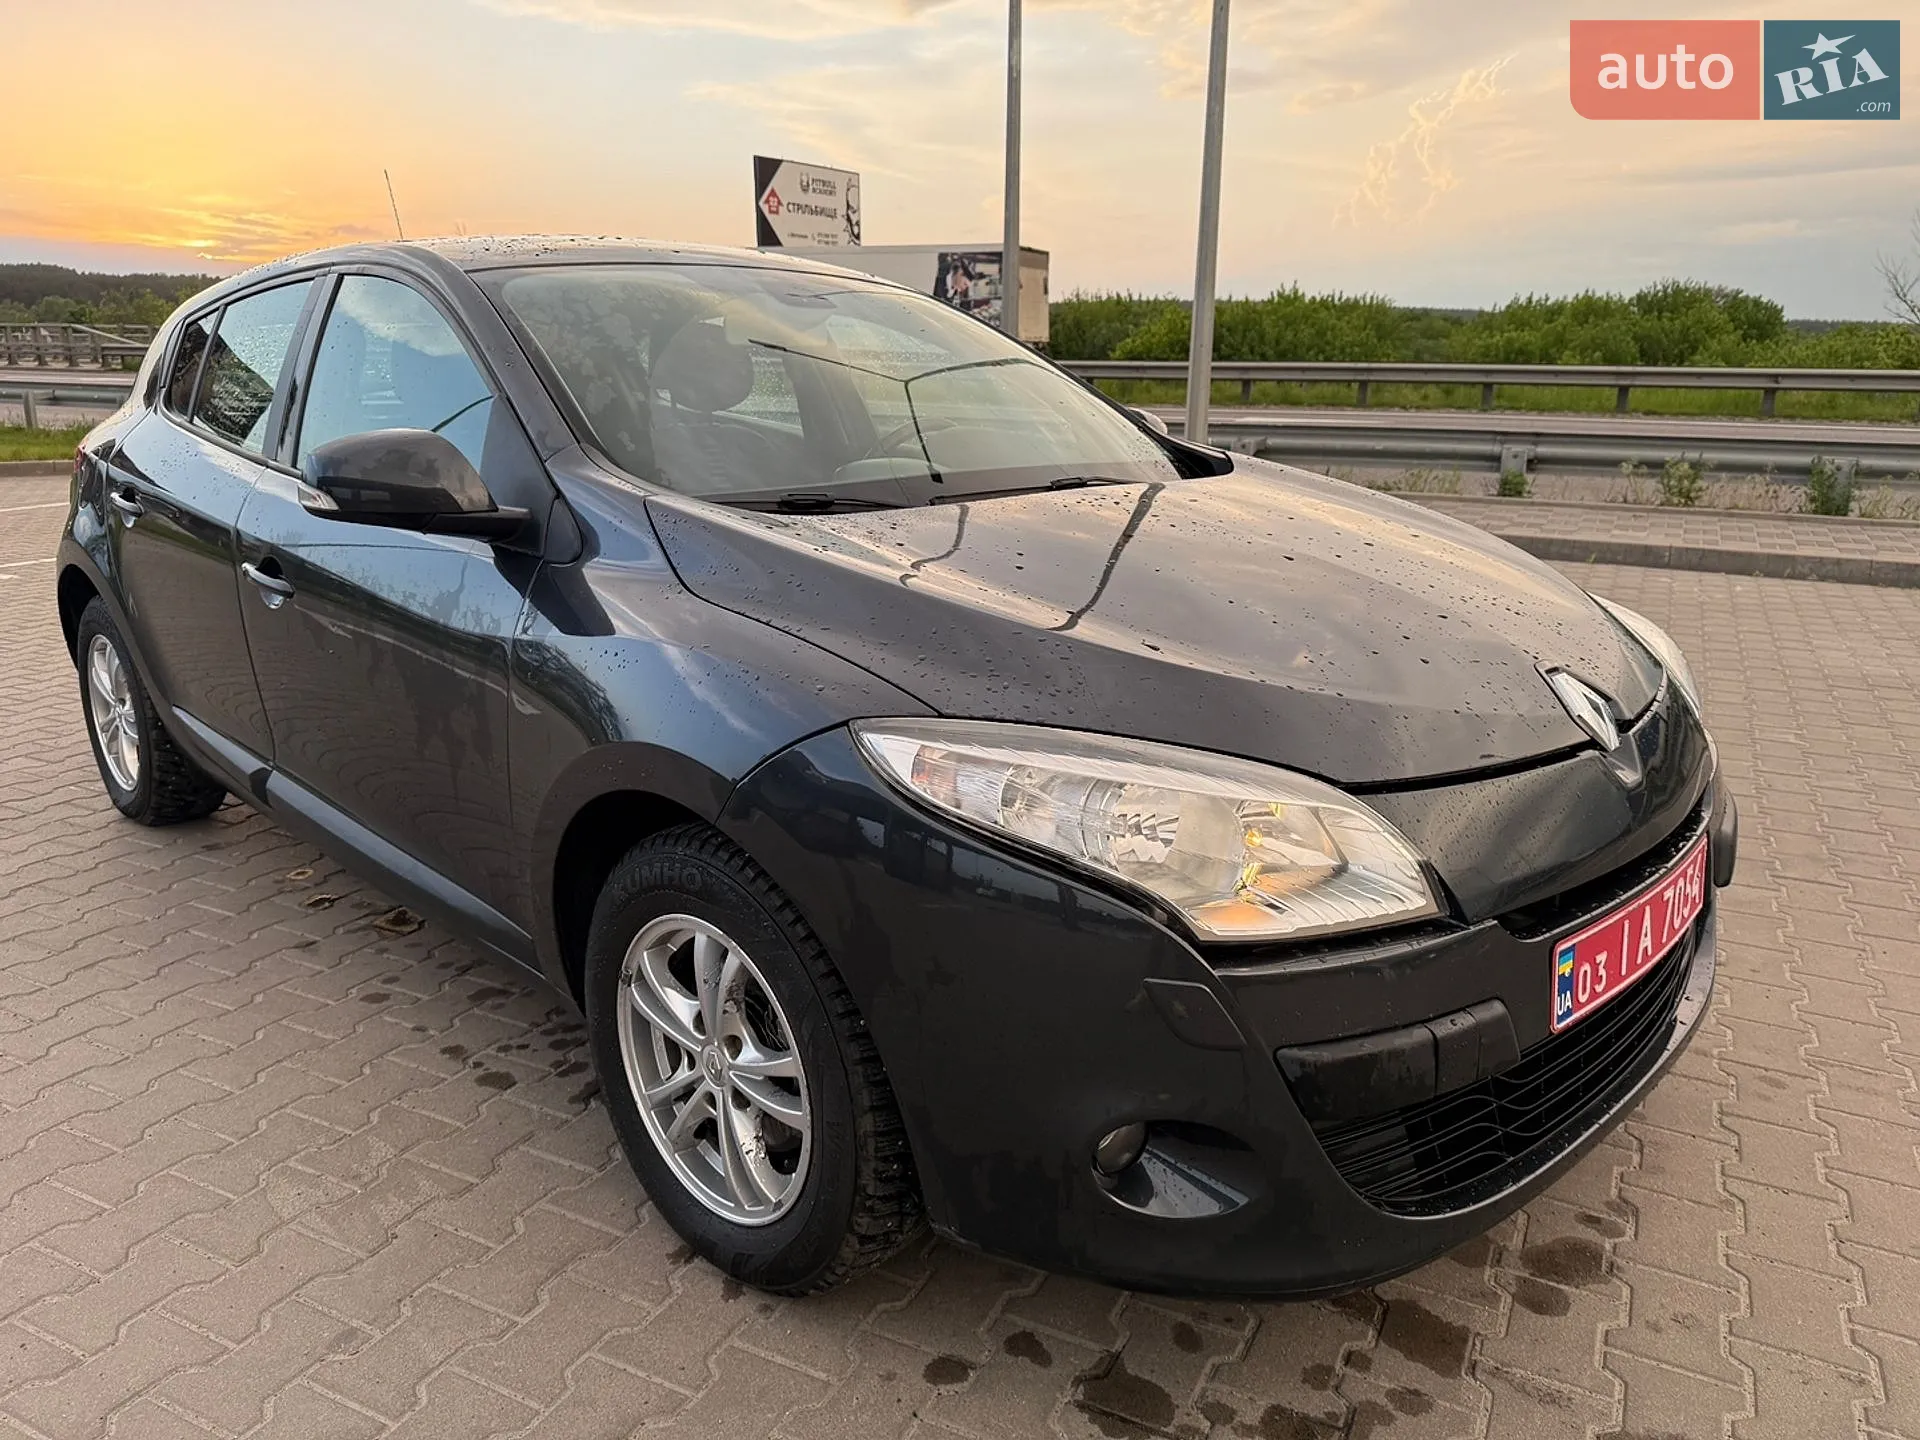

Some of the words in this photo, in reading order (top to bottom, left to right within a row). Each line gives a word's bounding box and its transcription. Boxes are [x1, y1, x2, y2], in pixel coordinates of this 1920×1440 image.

[1577, 952, 1608, 1004] 03
[1620, 904, 1653, 976] IA
[1557, 991, 1573, 1016] UA
